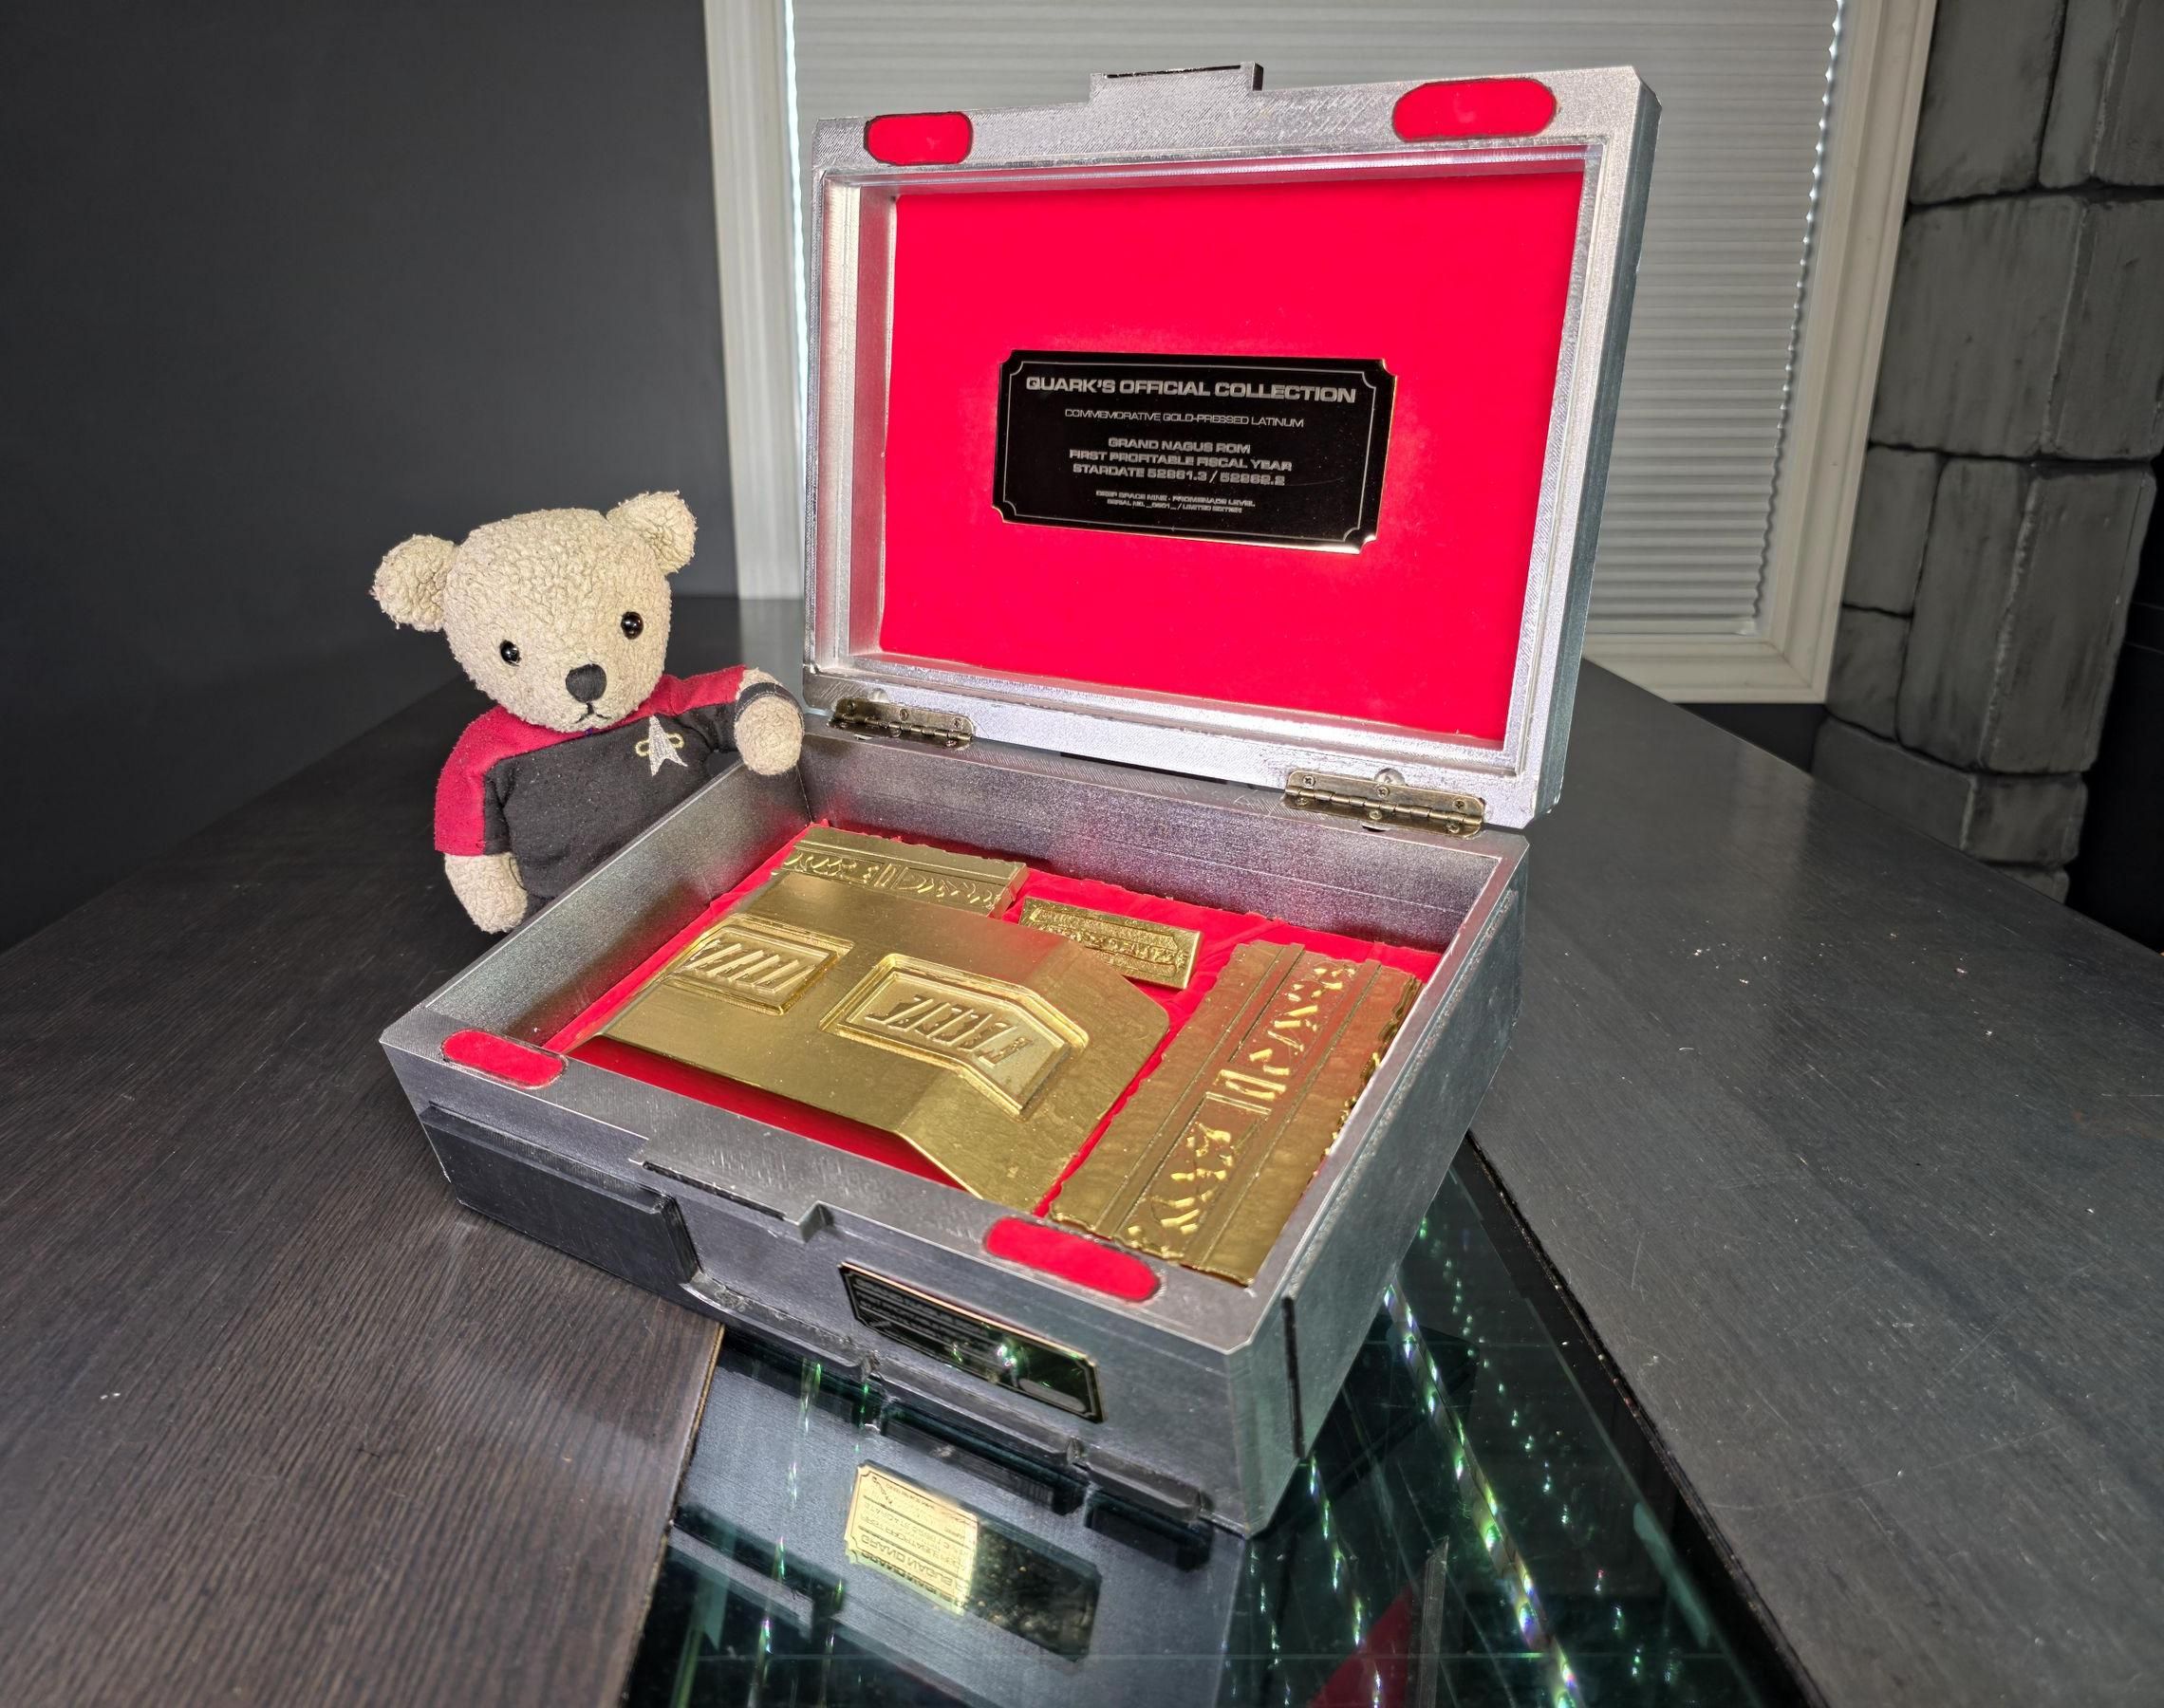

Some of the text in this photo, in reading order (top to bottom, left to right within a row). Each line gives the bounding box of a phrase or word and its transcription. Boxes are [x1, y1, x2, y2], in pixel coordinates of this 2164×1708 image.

[1025, 376, 1357, 403] QUARK'S OFFICIAL COLLECTION
[1064, 408, 1305, 428] COMMEMORATIVE GOLD-PRESSED LATINUM
[1108, 436, 1251, 455] GRAND NAGUS ROM
[1069, 449, 1293, 472] FIRST PROFITABLE FISCAL YEAR
[1073, 463, 1145, 478] STARDATE
[1208, 470, 1219, 484] /
[1107, 498, 1131, 507] SERIAL
[1118, 492, 1146, 500] SPACE
[1171, 495, 1228, 506] PROMENADE
